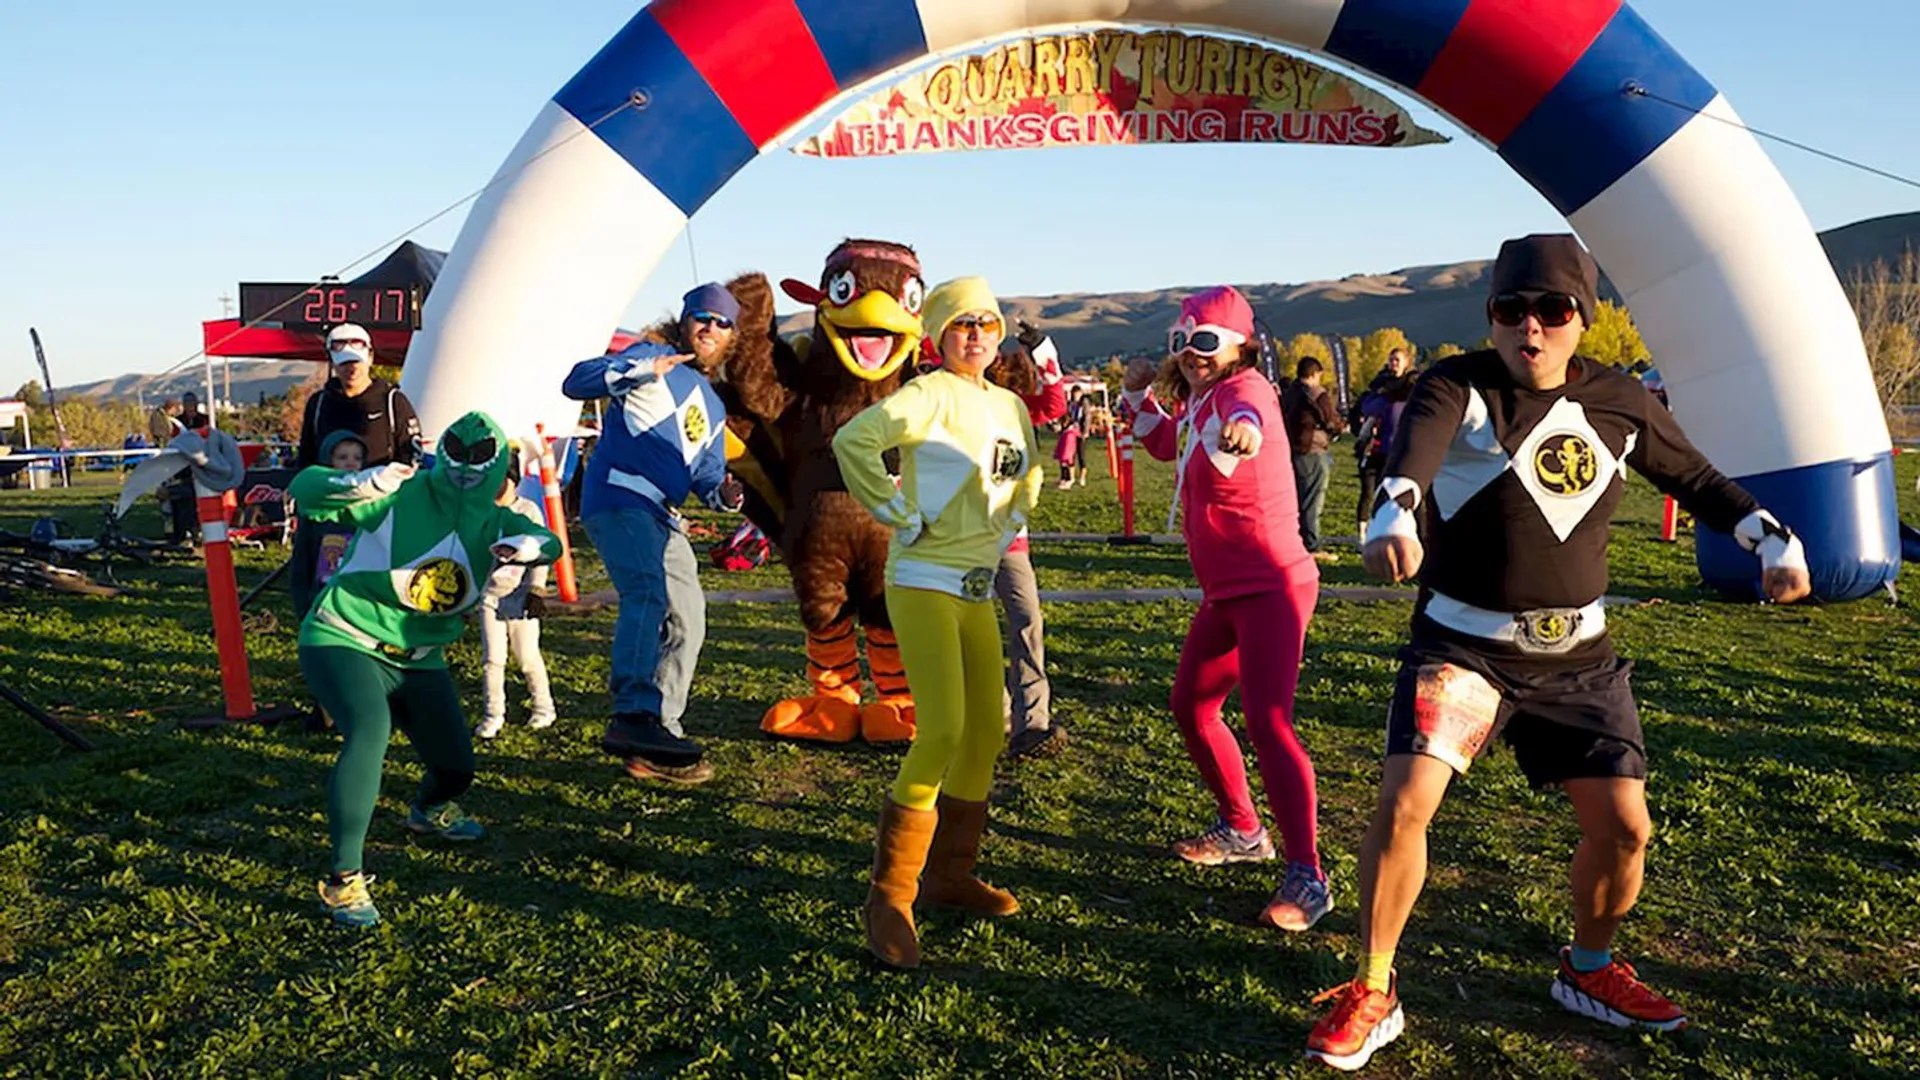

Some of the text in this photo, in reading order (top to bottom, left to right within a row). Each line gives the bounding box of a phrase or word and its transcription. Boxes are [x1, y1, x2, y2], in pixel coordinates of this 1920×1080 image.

[926, 30, 1322, 120] QUARRY TURKEY
[848, 108, 1387, 154] THANKSGIVING RUNS
